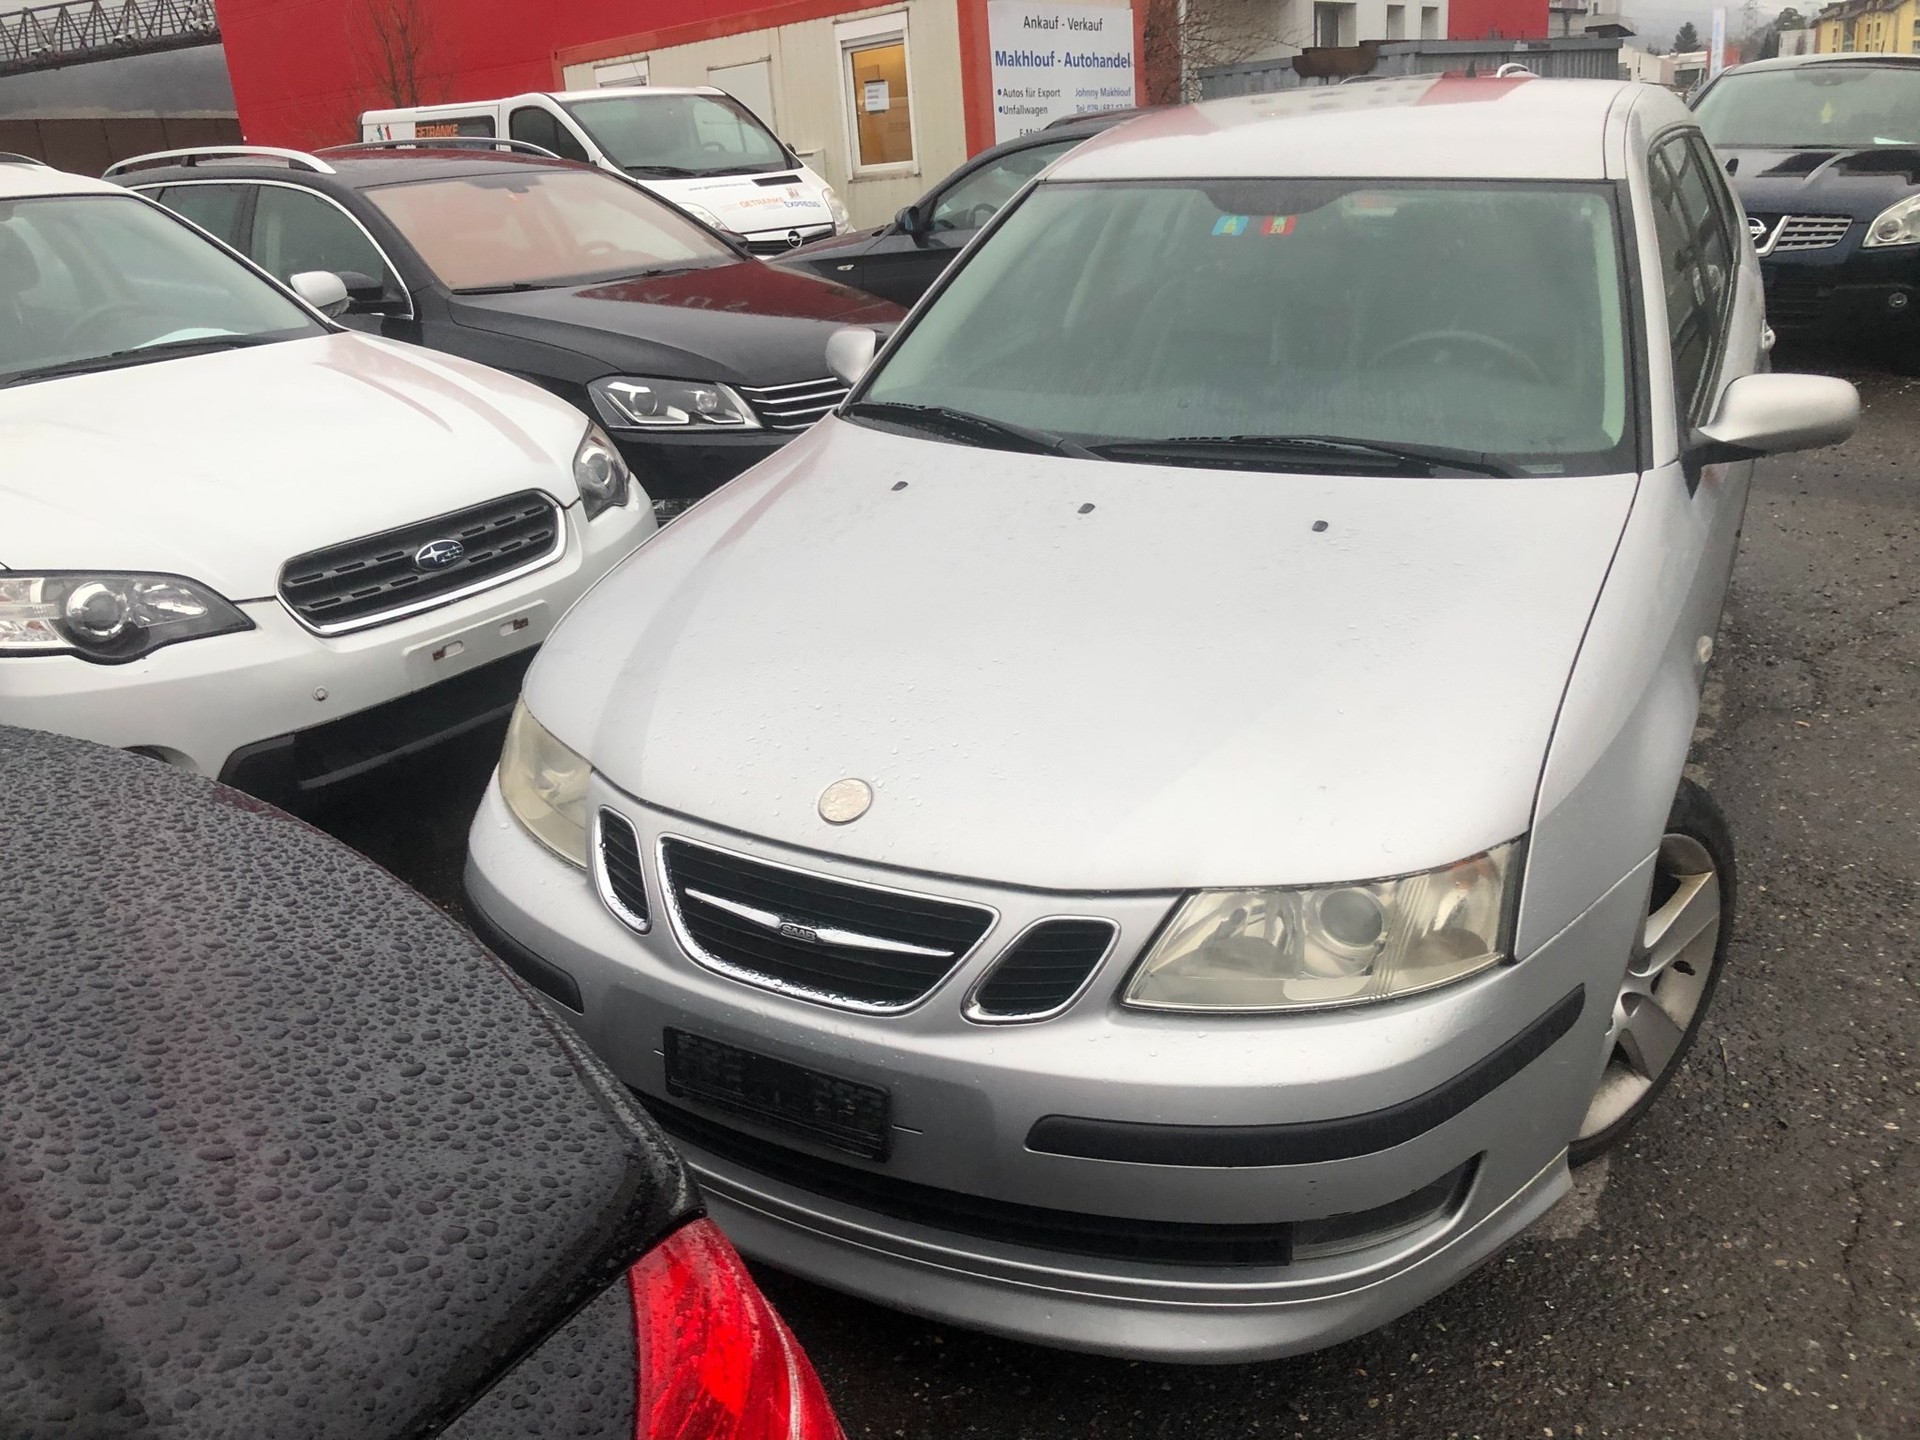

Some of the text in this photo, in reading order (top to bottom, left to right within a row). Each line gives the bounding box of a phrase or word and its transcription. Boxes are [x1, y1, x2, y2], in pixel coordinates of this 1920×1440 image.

[1023, 15, 1059, 30] Ankauf
[1067, 17, 1103, 32] Verkauf
[995, 50, 1055, 68] Makhlouf
[1063, 52, 1131, 69] Autohandel
[1003, 87, 1061, 99] Autos für Export
[1075, 87, 1131, 99] Johnny Makhlouf
[1003, 105, 1048, 117] Unfallwagen
